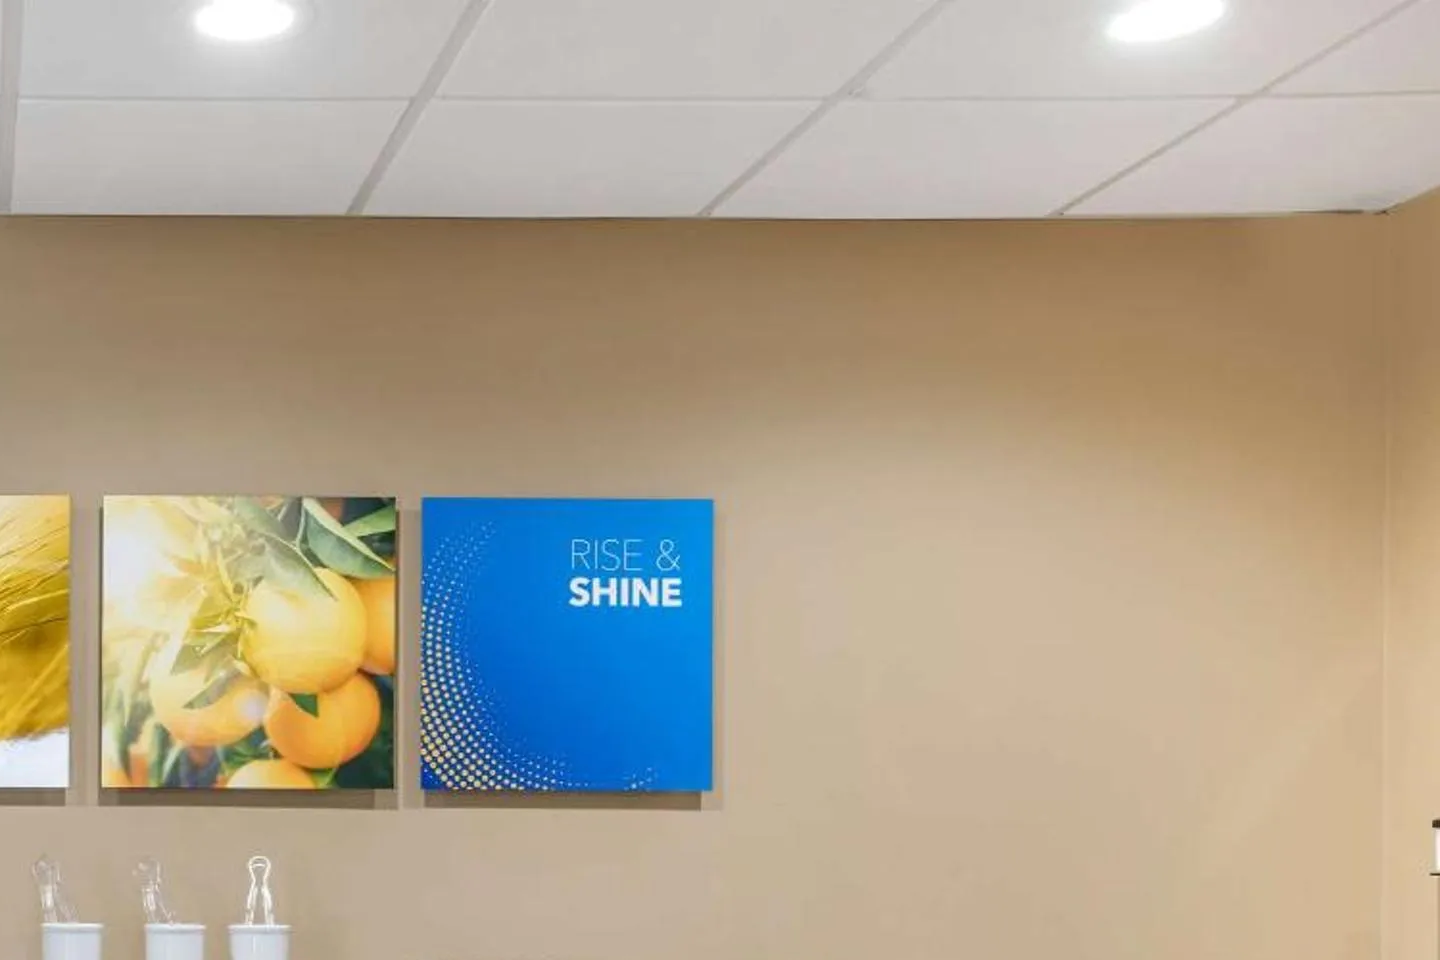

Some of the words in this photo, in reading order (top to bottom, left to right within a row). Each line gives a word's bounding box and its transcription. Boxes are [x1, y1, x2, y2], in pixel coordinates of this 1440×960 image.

[571, 538, 643, 571] RISE
[656, 538, 681, 571] &
[568, 577, 682, 607] SHINE
